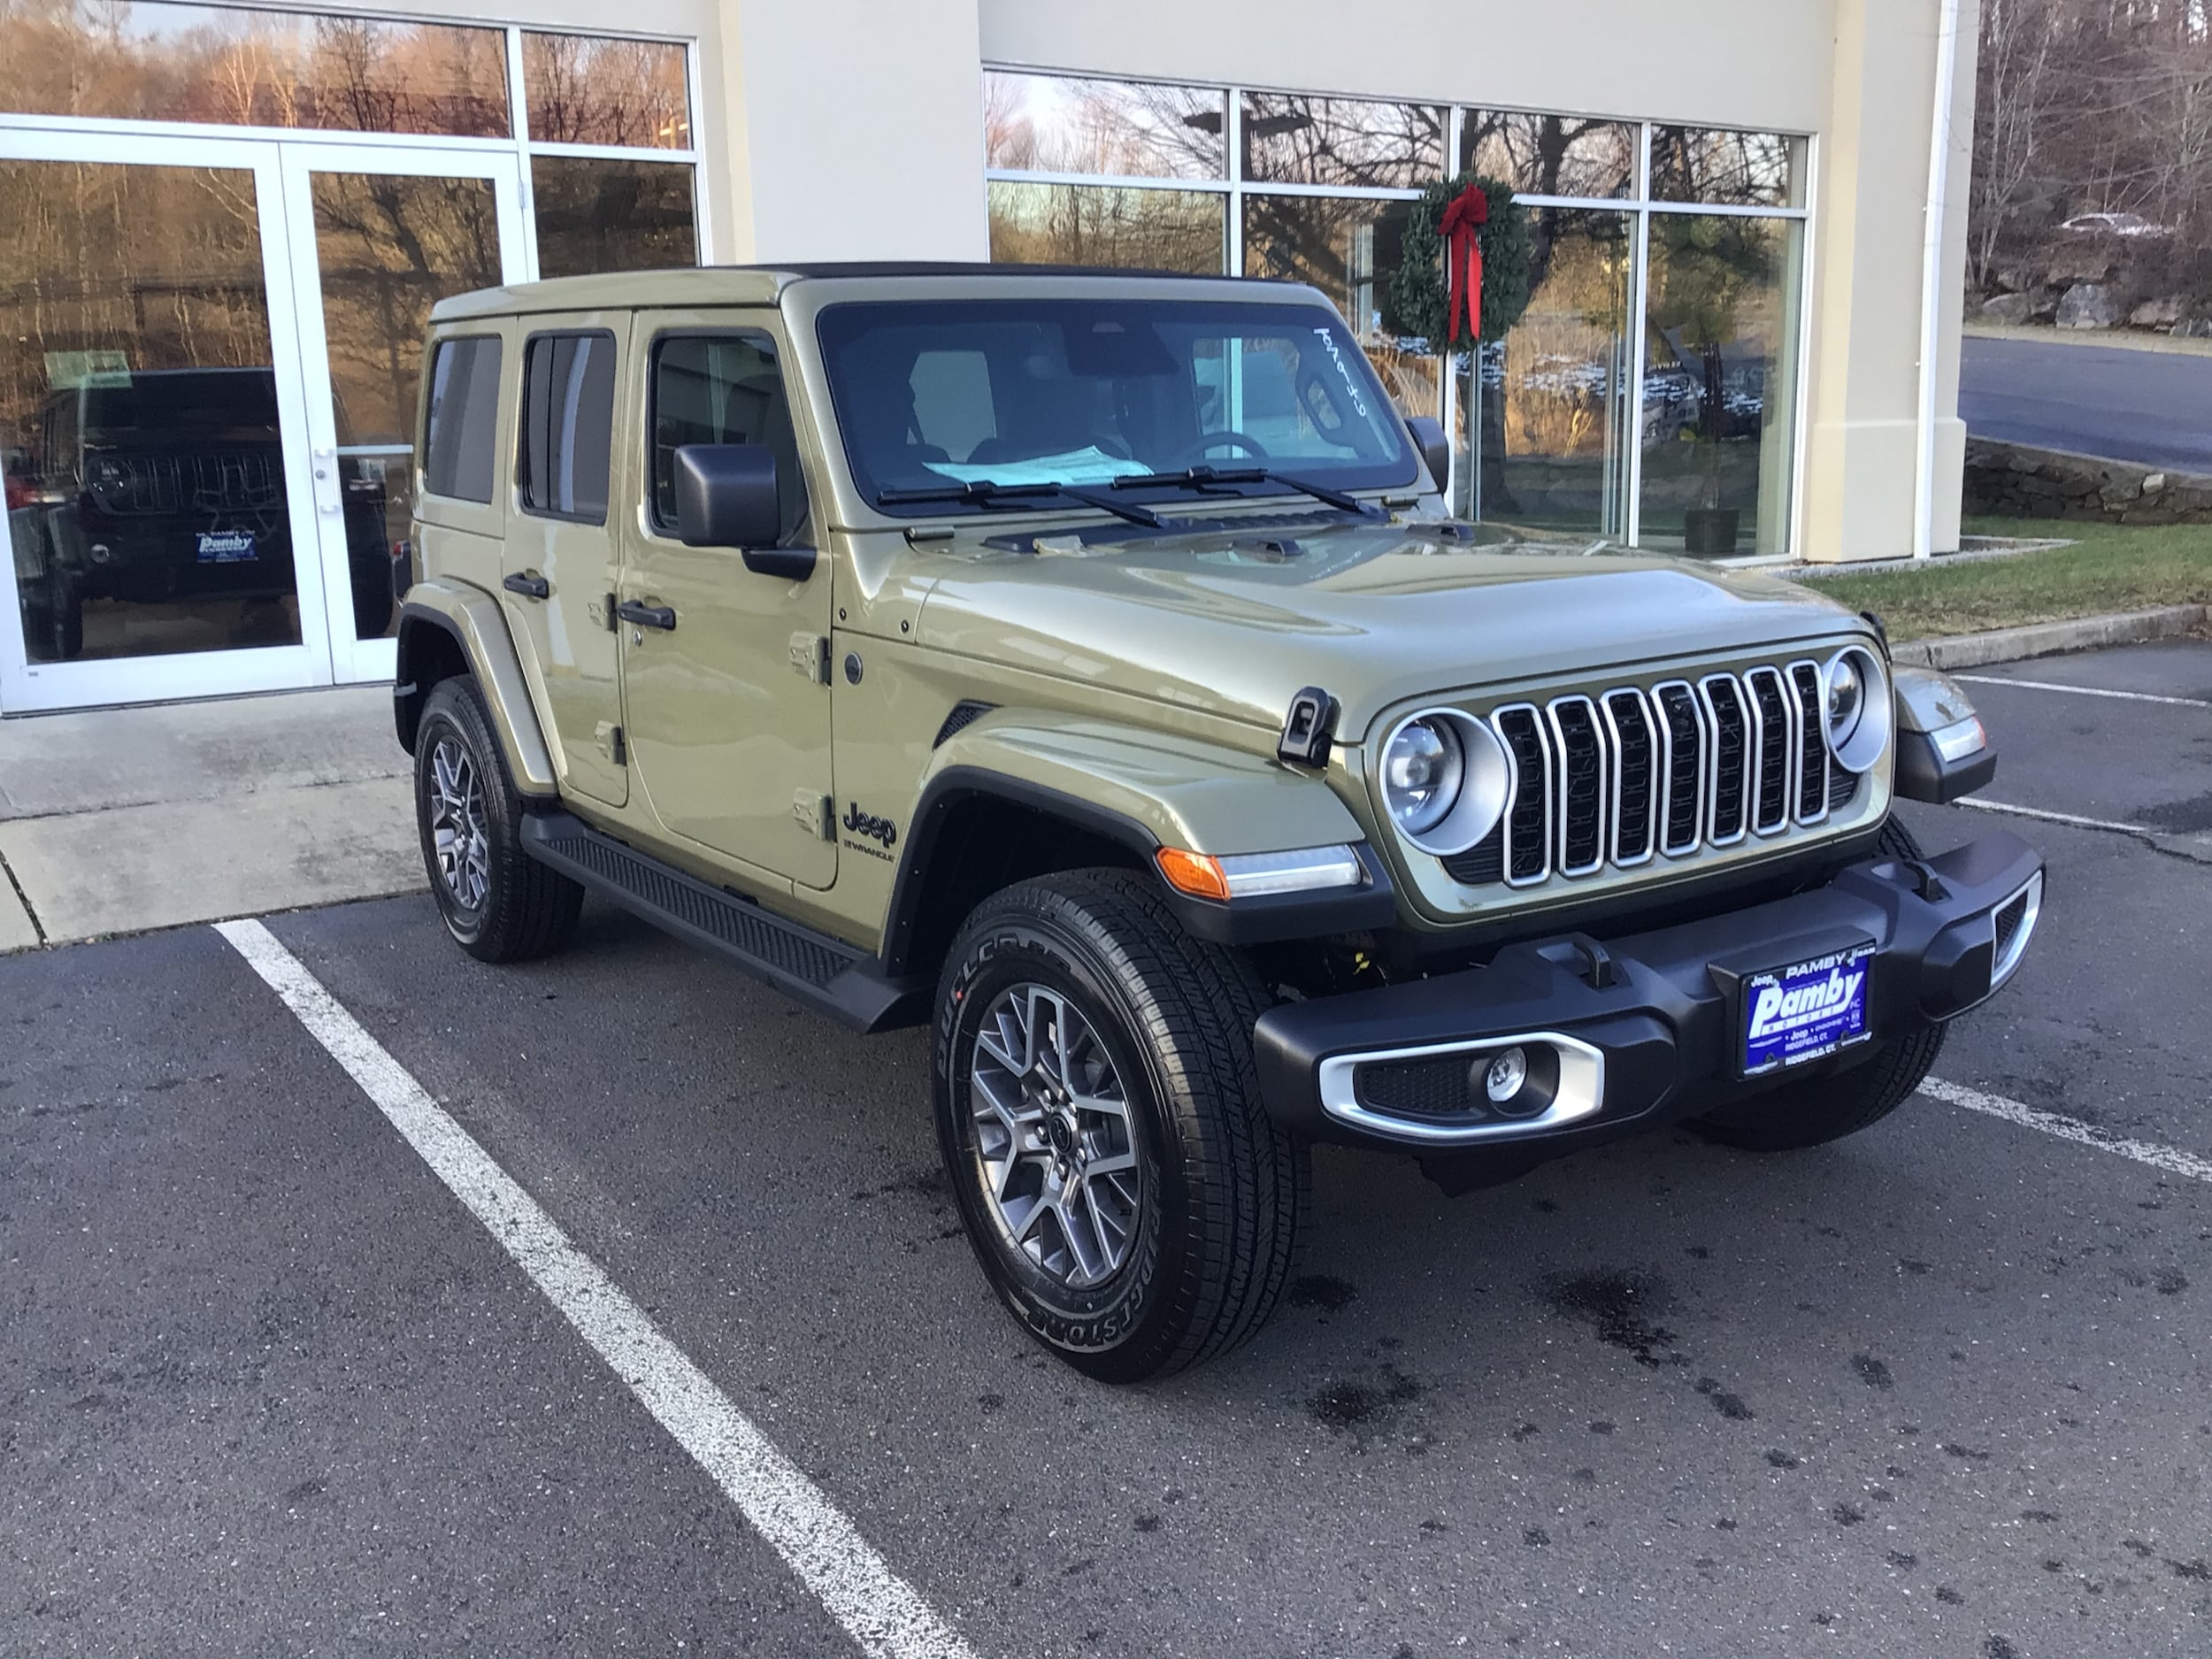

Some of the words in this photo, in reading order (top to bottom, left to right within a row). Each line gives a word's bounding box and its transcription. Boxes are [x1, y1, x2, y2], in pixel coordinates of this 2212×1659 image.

[199, 535, 252, 552] Pamby
[842, 802, 896, 849] Jeep
[1786, 952, 1847, 979] PAMBY
[1748, 968, 1864, 1040] Pamby
